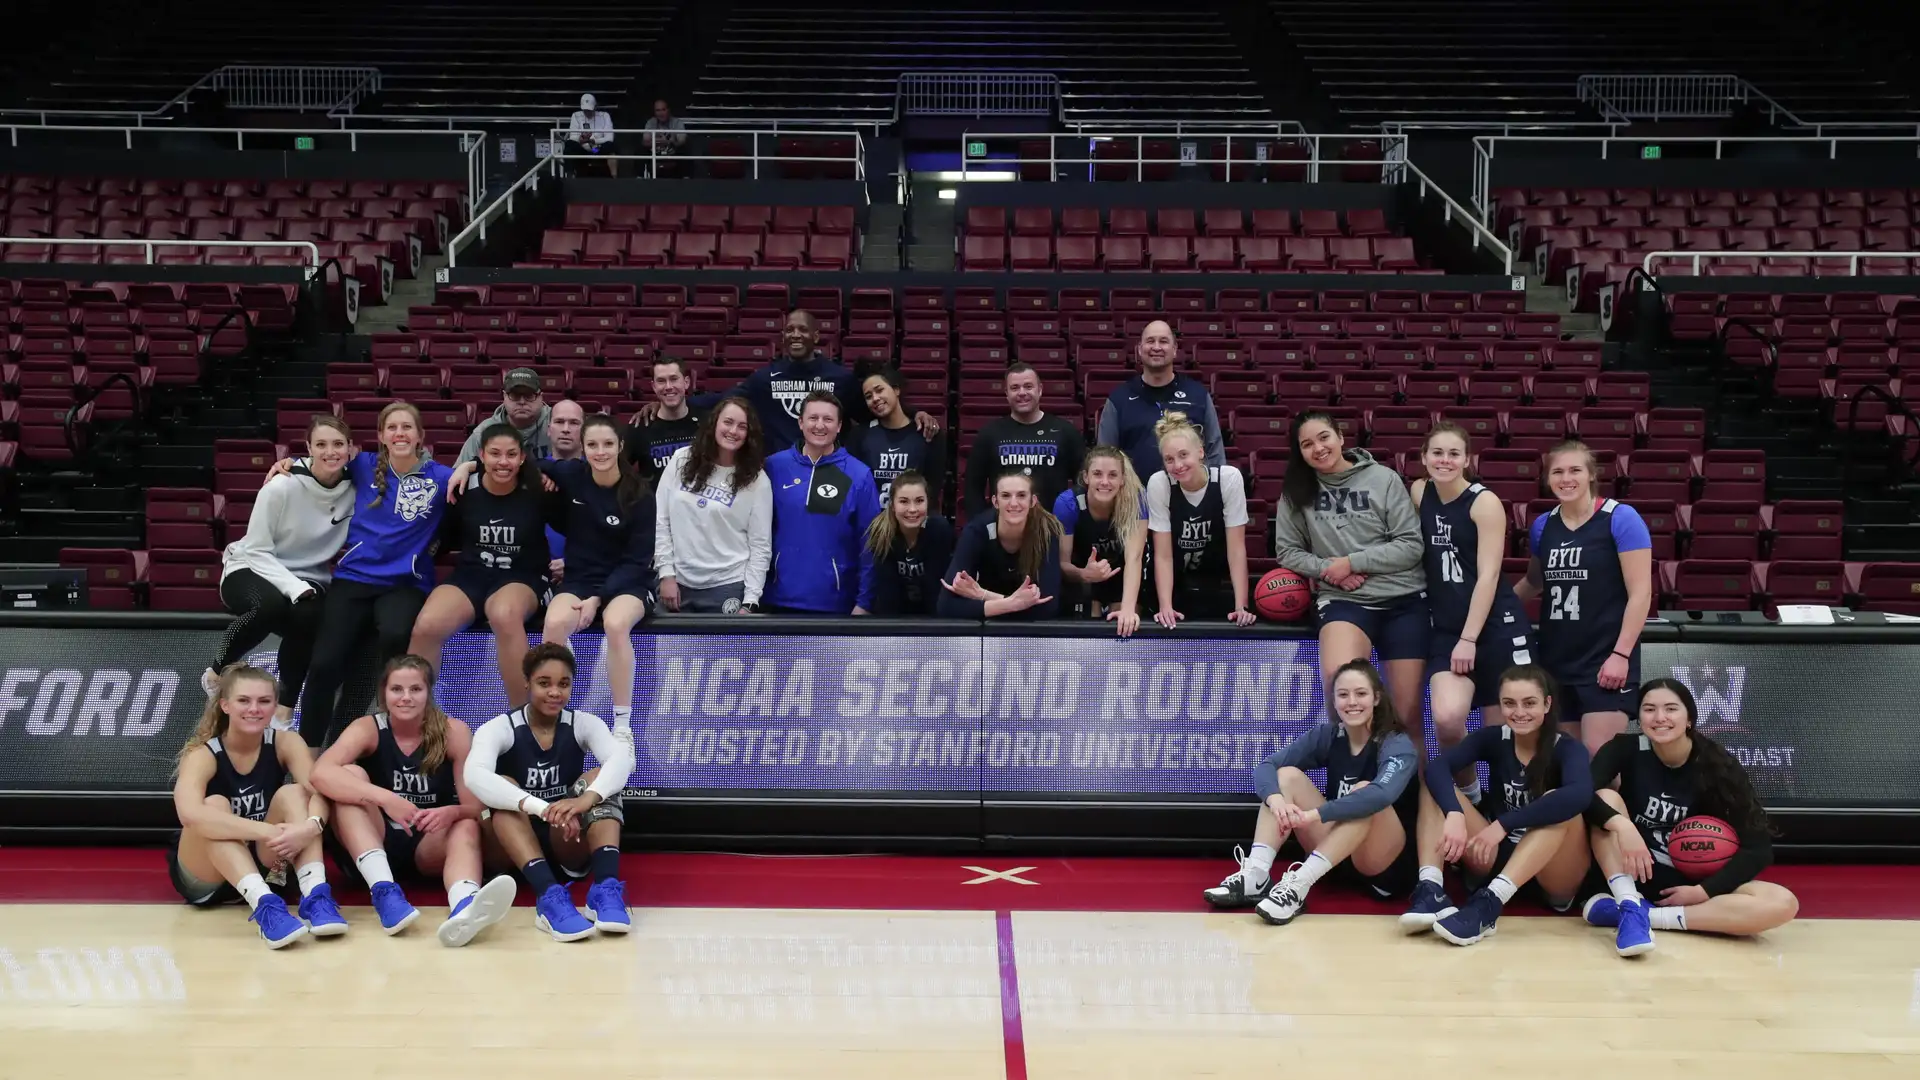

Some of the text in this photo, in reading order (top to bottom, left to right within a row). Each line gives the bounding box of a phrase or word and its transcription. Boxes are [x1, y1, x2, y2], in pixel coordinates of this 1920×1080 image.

[1644, 146, 1660, 158] EXIT
[439, 272, 446, 282] 3
[1515, 281, 1522, 290] 3
[771, 380, 835, 393] BRIGHAM YOUNG
[879, 453, 908, 469] BYU
[1000, 445, 1057, 466] CHAMPS
[403, 483, 421, 492] BYU
[1315, 487, 1370, 514] BYU
[480, 525, 515, 544] BYU
[1182, 520, 1211, 539] BYU
[1441, 550, 1464, 583] 10
[1547, 546, 1582, 568] BYU
[1266, 576, 1303, 591] Wilson
[1545, 570, 1586, 579] BASKETBALL
[1549, 585, 1580, 620] 24
[657, 657, 1317, 722] NCAA SECOND ROUND
[667, 728, 806, 766] HOSTED
[816, 730, 866, 766] BY
[873, 731, 1059, 768] STANFORD
[393, 769, 429, 793] BYU
[525, 765, 560, 788] BYU
[231, 790, 265, 817] BYU
[1644, 795, 1688, 823] BYU
[1674, 820, 1723, 835] Wilson
[1681, 841, 1716, 852] NCAA
